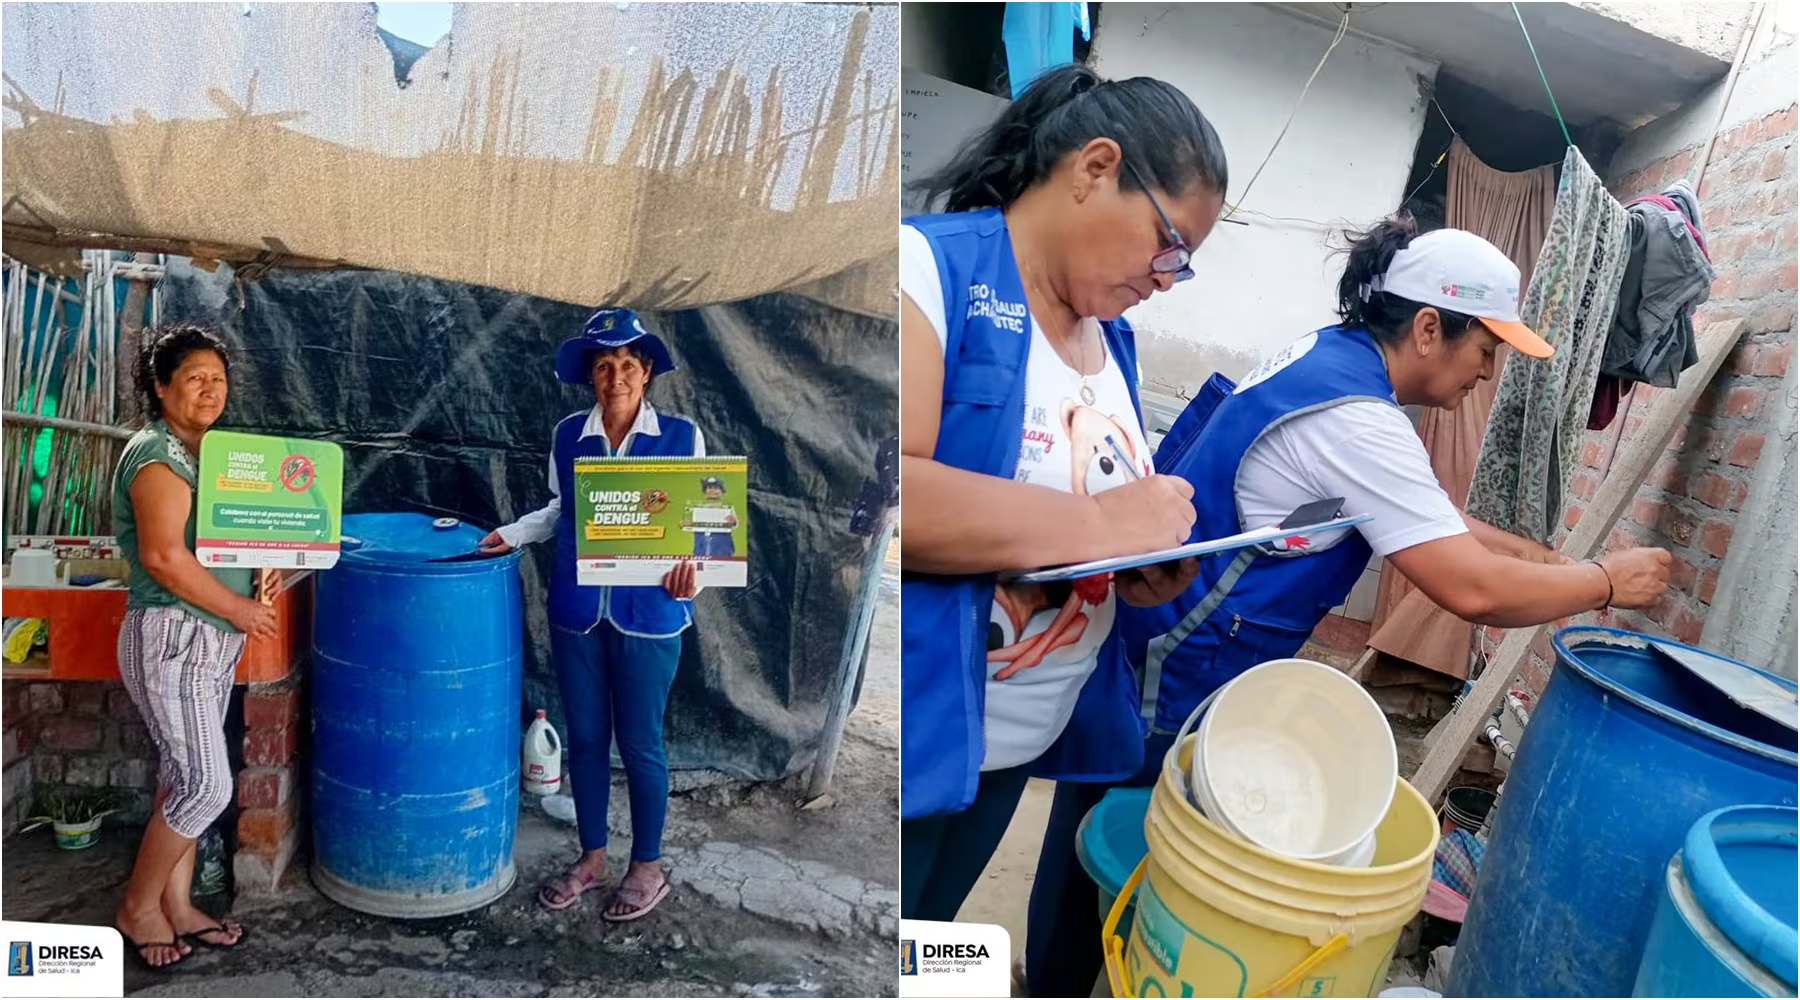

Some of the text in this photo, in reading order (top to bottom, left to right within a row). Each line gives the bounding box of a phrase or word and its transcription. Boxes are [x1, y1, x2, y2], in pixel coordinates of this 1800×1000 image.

[1031, 407, 1047, 427] ARE
[228, 451, 265, 464] UNIDOS
[227, 468, 268, 481] DENGUE
[589, 491, 641, 503] UNIDOS
[595, 503, 637, 512] CONTRA el
[593, 512, 650, 525] DENGUE
[1312, 979, 1324, 994] 5
